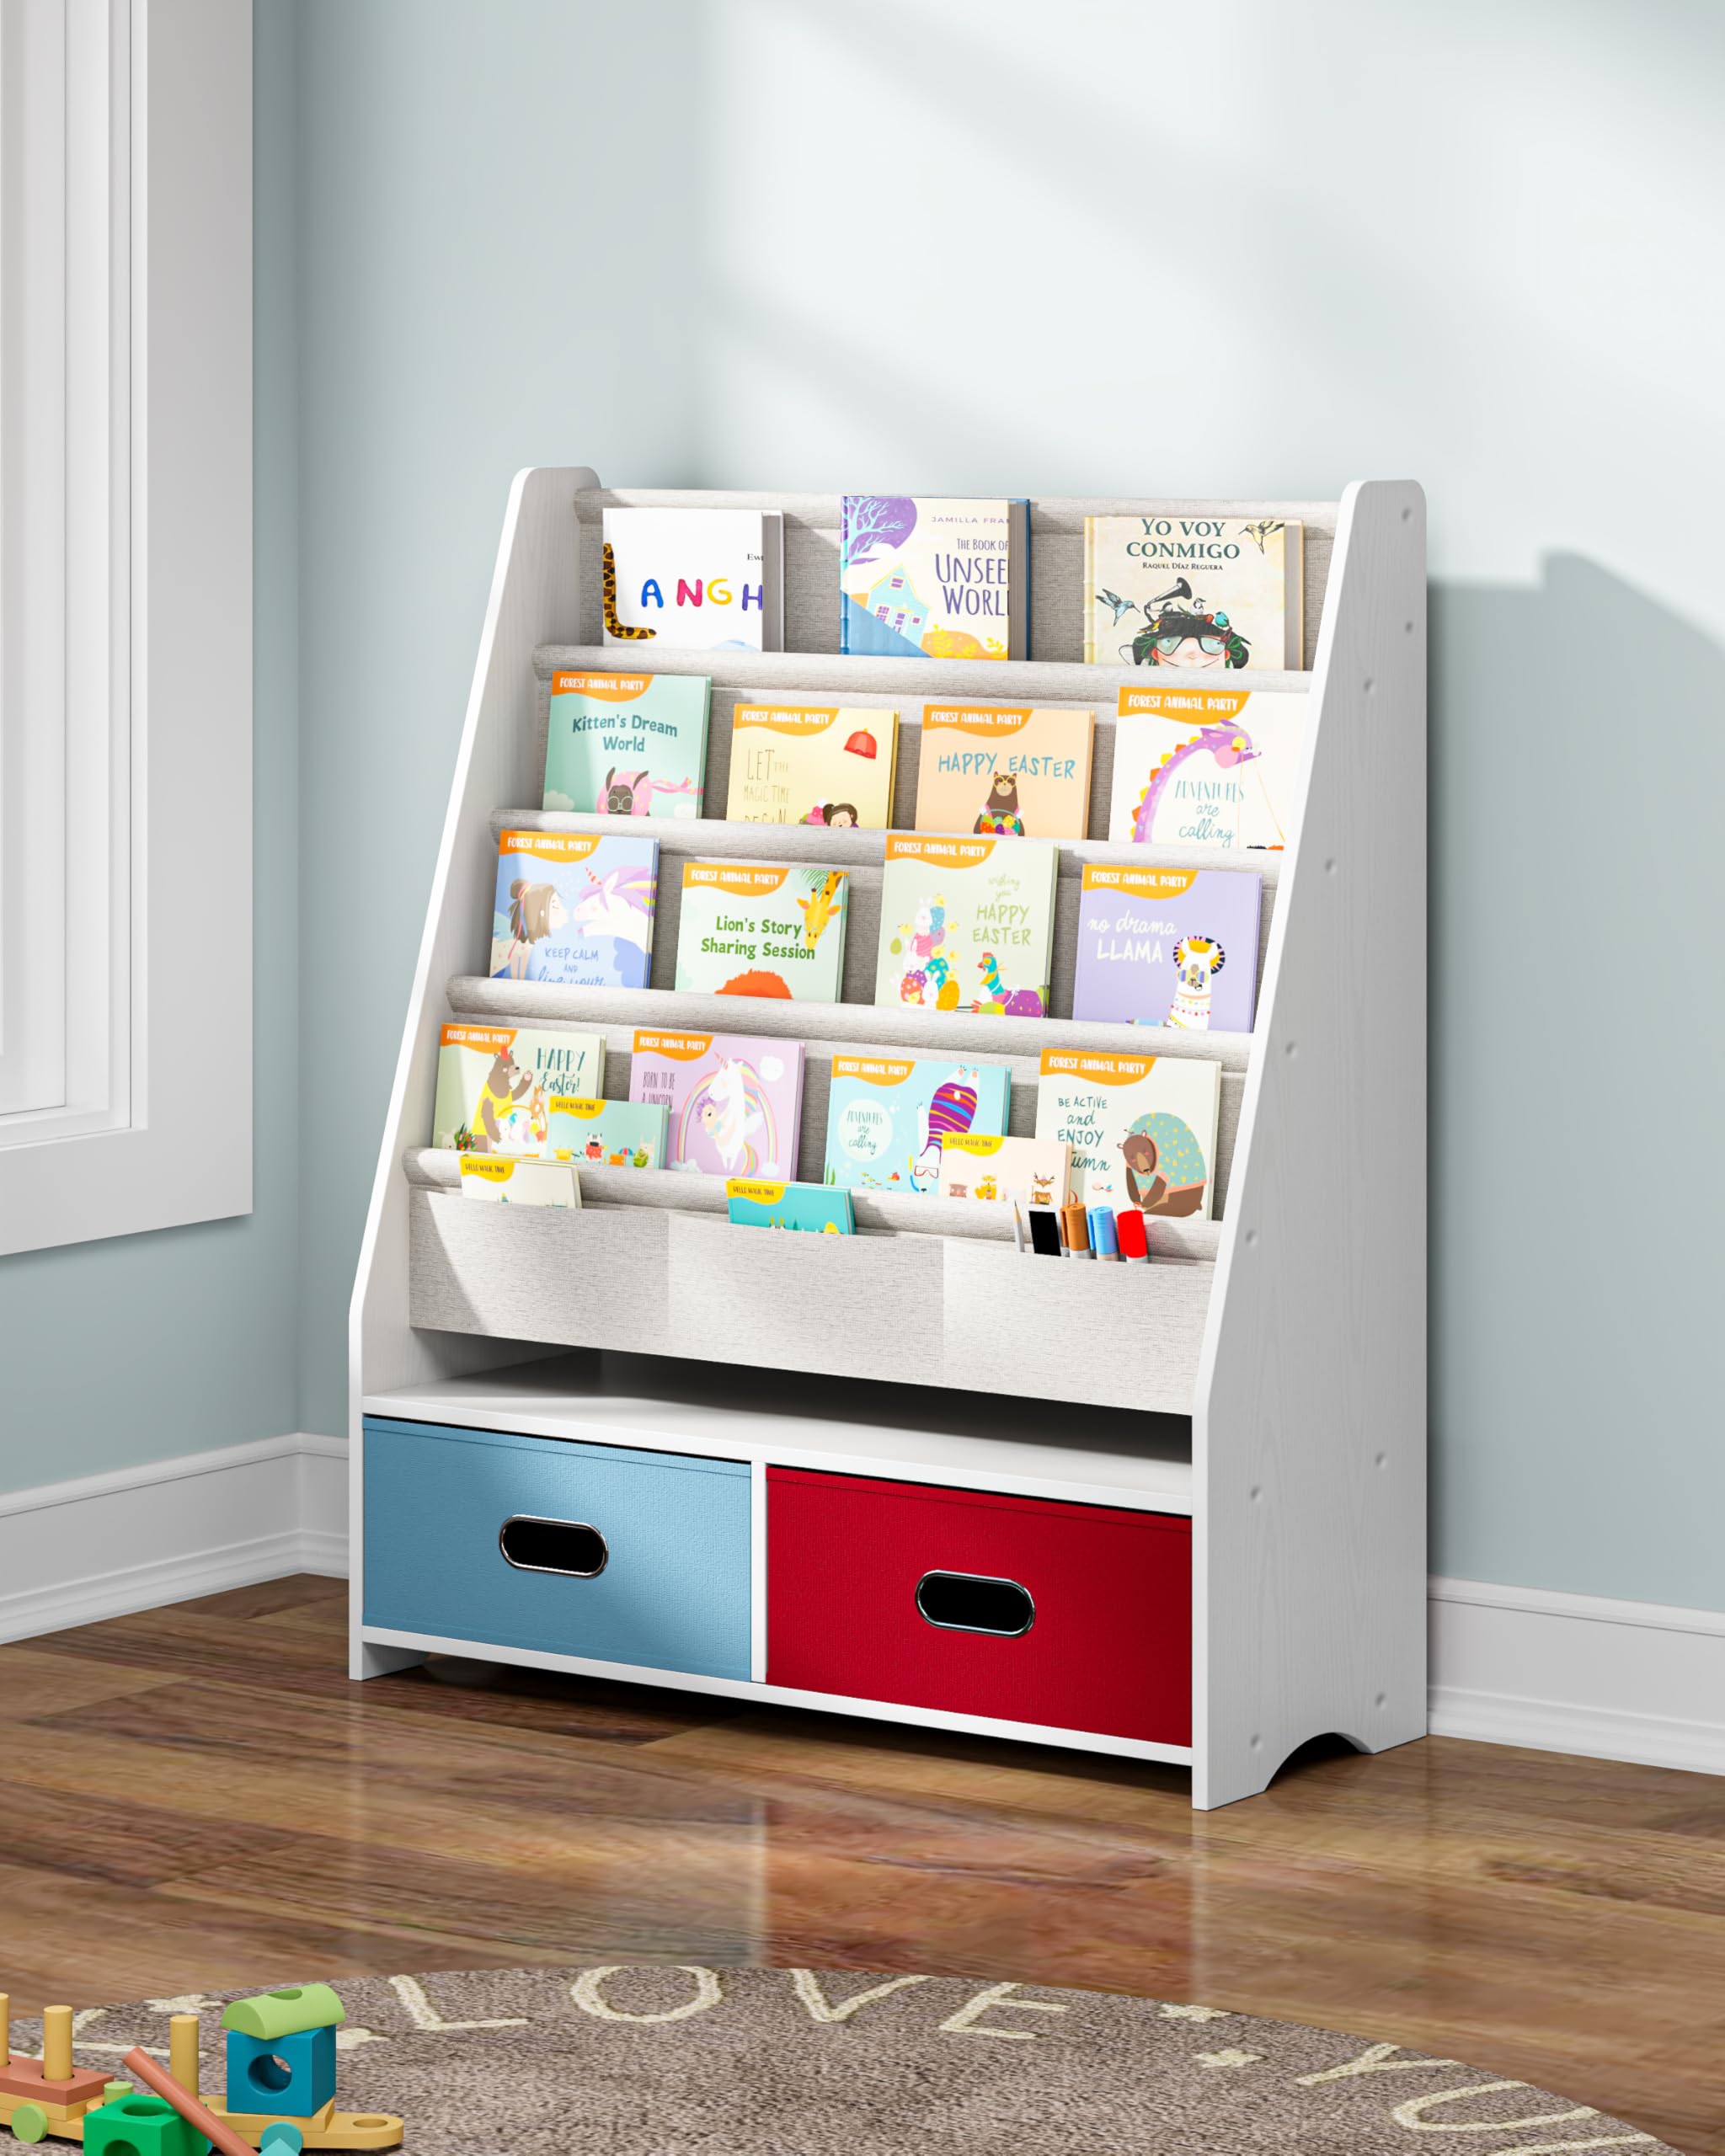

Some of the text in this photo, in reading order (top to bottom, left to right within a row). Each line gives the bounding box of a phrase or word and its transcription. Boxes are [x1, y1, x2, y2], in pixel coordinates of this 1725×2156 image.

[1141, 519, 1226, 537] YO VOY
[957, 538, 1009, 551] THE BOOK OF
[1126, 542, 1241, 559] CONMIGO
[935, 553, 1010, 584] UNSEE
[1142, 562, 1170, 570] RAQUEL
[1191, 563, 1224, 571] REGUERA
[943, 584, 1010, 616] WORL
[560, 677, 644, 691] FOREST ANIMAL PARTY
[1128, 695, 1239, 711] FOREST ANIMAL PARTY
[573, 714, 678, 737] Kitten's Dream
[741, 711, 830, 725] FOREST ANIMAL PARTY
[931, 711, 1023, 726] FOREST ANIMAL PARTY
[603, 736, 645, 752] World
[747, 748, 775, 782] LET
[938, 752, 1076, 780] HAPPY EASTER
[1196, 803, 1220, 817] are
[1179, 818, 1235, 848] calling
[507, 837, 593, 852] FOREST ANIMAL PARTY
[894, 841, 986, 857] FOREST ANIMAL PARTY
[691, 870, 780, 885] FOREST ANIMAL PARTY
[1092, 872, 1188, 888] FOREST ANIMAL PARTY
[976, 902, 1030, 926] HAPPY
[716, 915, 803, 939] Lion's Story
[1087, 910, 1178, 935] no drama
[973, 926, 1032, 947] EASTER
[545, 947, 599, 962] KEEP CALM
[701, 937, 816, 960] Sharing Session
[1097, 938, 1163, 963] LLAMA
[564, 963, 579, 973] AND
[639, 1037, 706, 1051] FOREST ANIMAL PARTY
[537, 1048, 585, 1072] HAPPY
[838, 1060, 909, 1076] FOREST ANIMAL PARTY
[1049, 1056, 1146, 1074] FOREST ANIMAL PARTY
[542, 1071, 580, 1096] Easter!
[1058, 1096, 1108, 1109] BE ACTIVE
[1067, 1110, 1096, 1126] and
[1058, 1129, 1104, 1147] ENJOY
